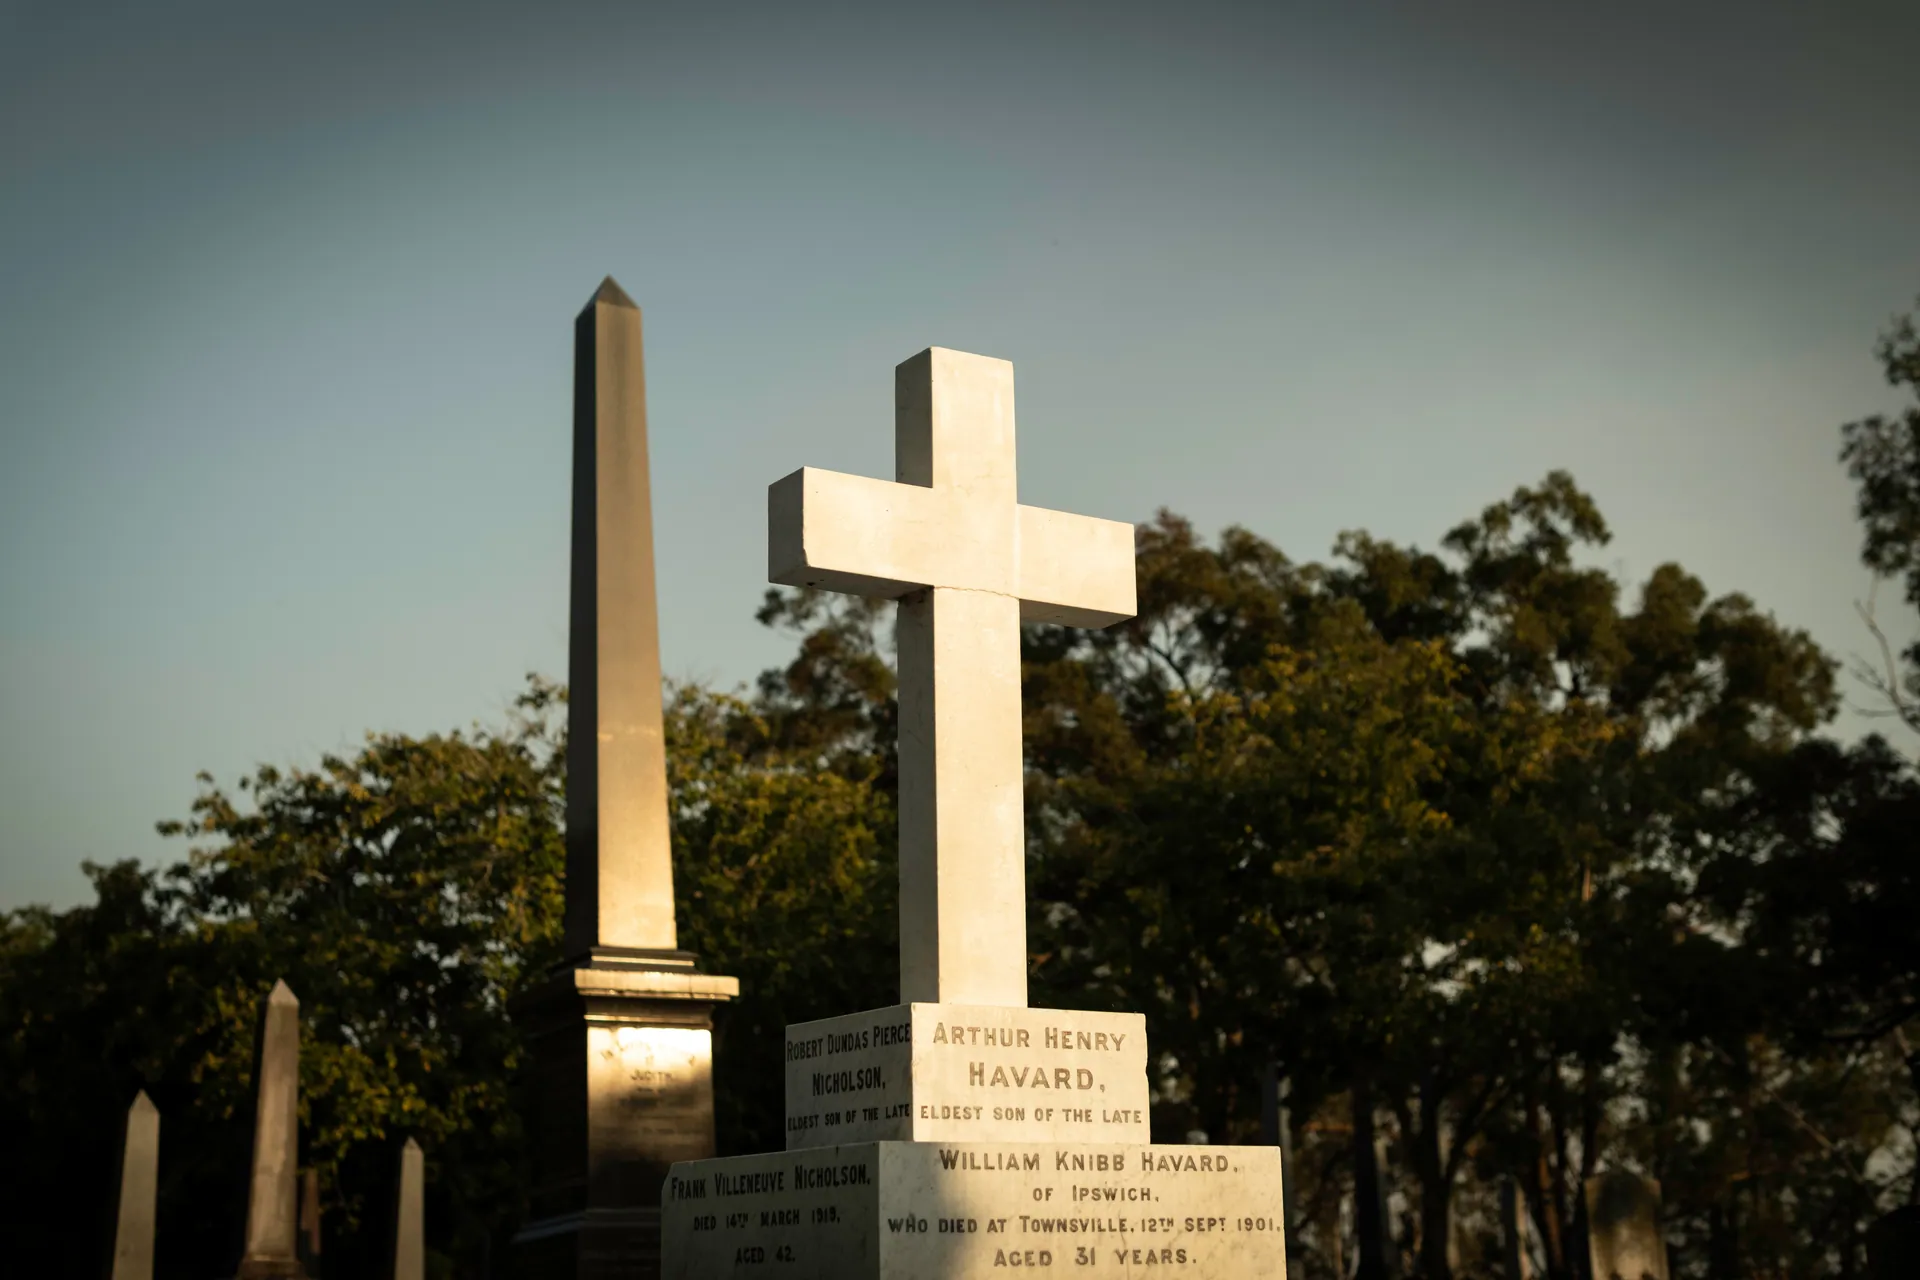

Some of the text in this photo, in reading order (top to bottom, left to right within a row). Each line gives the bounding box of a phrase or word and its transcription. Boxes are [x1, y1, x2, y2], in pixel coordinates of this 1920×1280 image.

[787, 1023, 910, 1062] ROBERT DUNDAS PIERCE
[933, 1022, 1126, 1051] ARTHUR HENRY
[813, 1066, 886, 1096] NICHOLSON,
[969, 1062, 1105, 1092] HAVARD,
[788, 1104, 909, 1131] ELDEST SON OF THE LATE
[921, 1106, 1142, 1124] ELDEST SON OF THE LATE
[939, 1149, 1040, 1171] WILLIAM
[1056, 1151, 1124, 1171] KNIBB
[672, 1177, 706, 1199] FRANK
[715, 1172, 784, 1197] VILLENEUVE
[1033, 1185, 1159, 1202] OF IPSWICH,
[694, 1215, 716, 1231] DIED
[761, 1209, 799, 1227] MARCH
[888, 1218, 927, 1233] WHO
[939, 1219, 977, 1233] DIED
[987, 1219, 1007, 1233] AT
[1019, 1216, 1134, 1233] TOWNSVILLE,
[735, 1247, 764, 1265] AGED
[994, 1247, 1197, 1267] AGED 31 YEARS.
